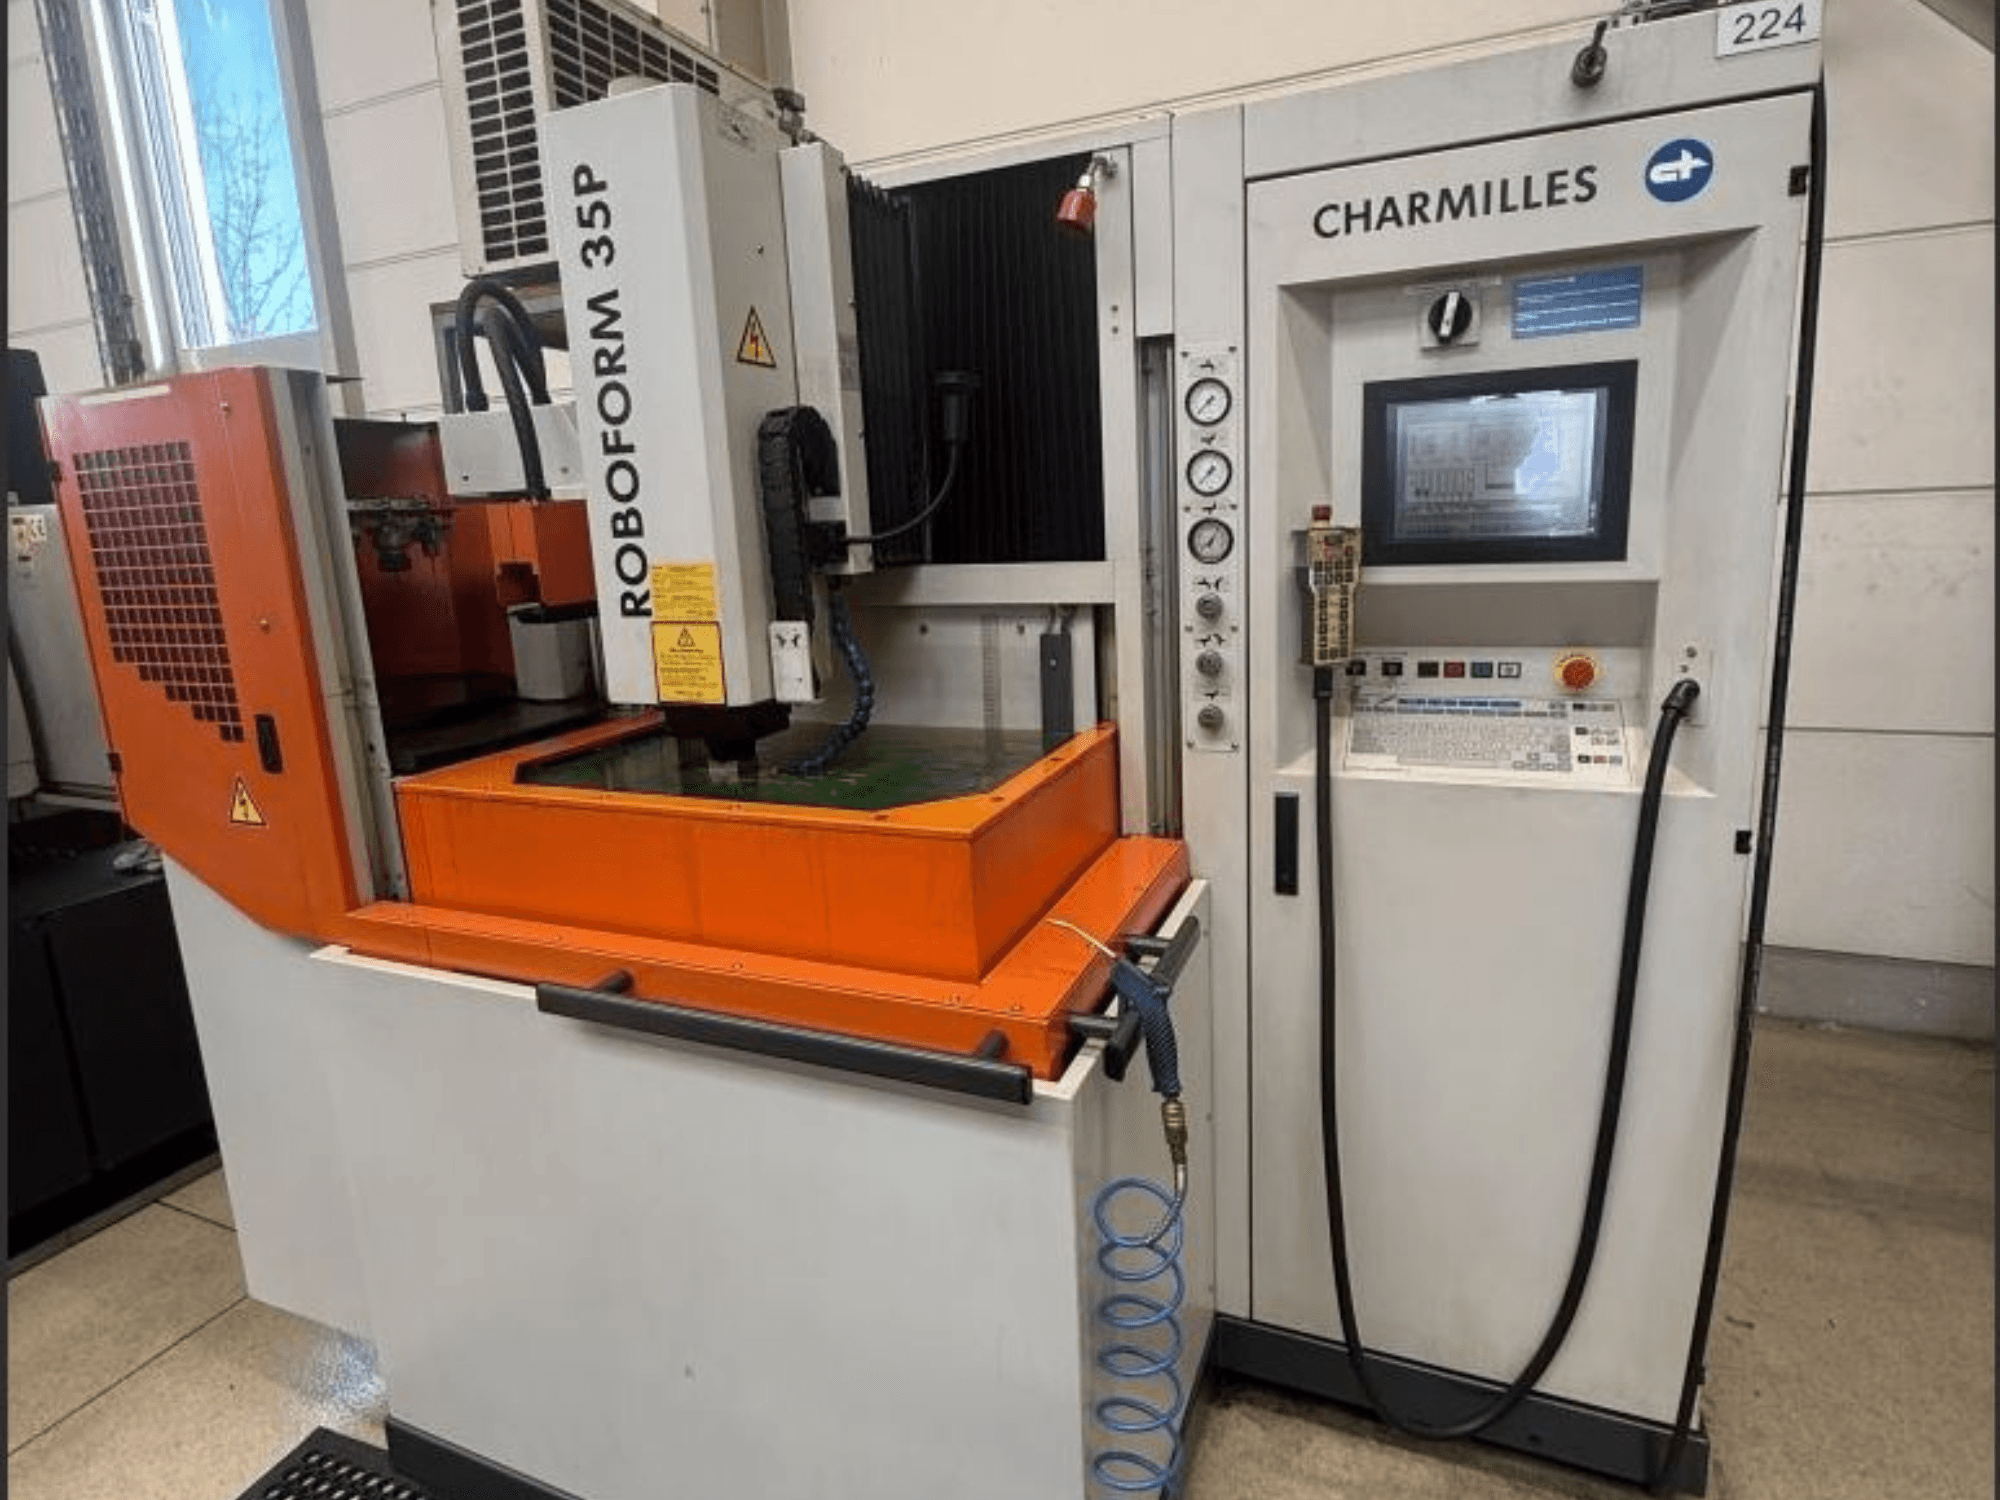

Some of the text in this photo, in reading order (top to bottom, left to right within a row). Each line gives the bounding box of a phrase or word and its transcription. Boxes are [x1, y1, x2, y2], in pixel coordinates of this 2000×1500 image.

[1732, 4, 1806, 45] 224
[1313, 165, 1598, 239] CHARMILLES
[573, 164, 653, 618] ROBOFORM 35P
